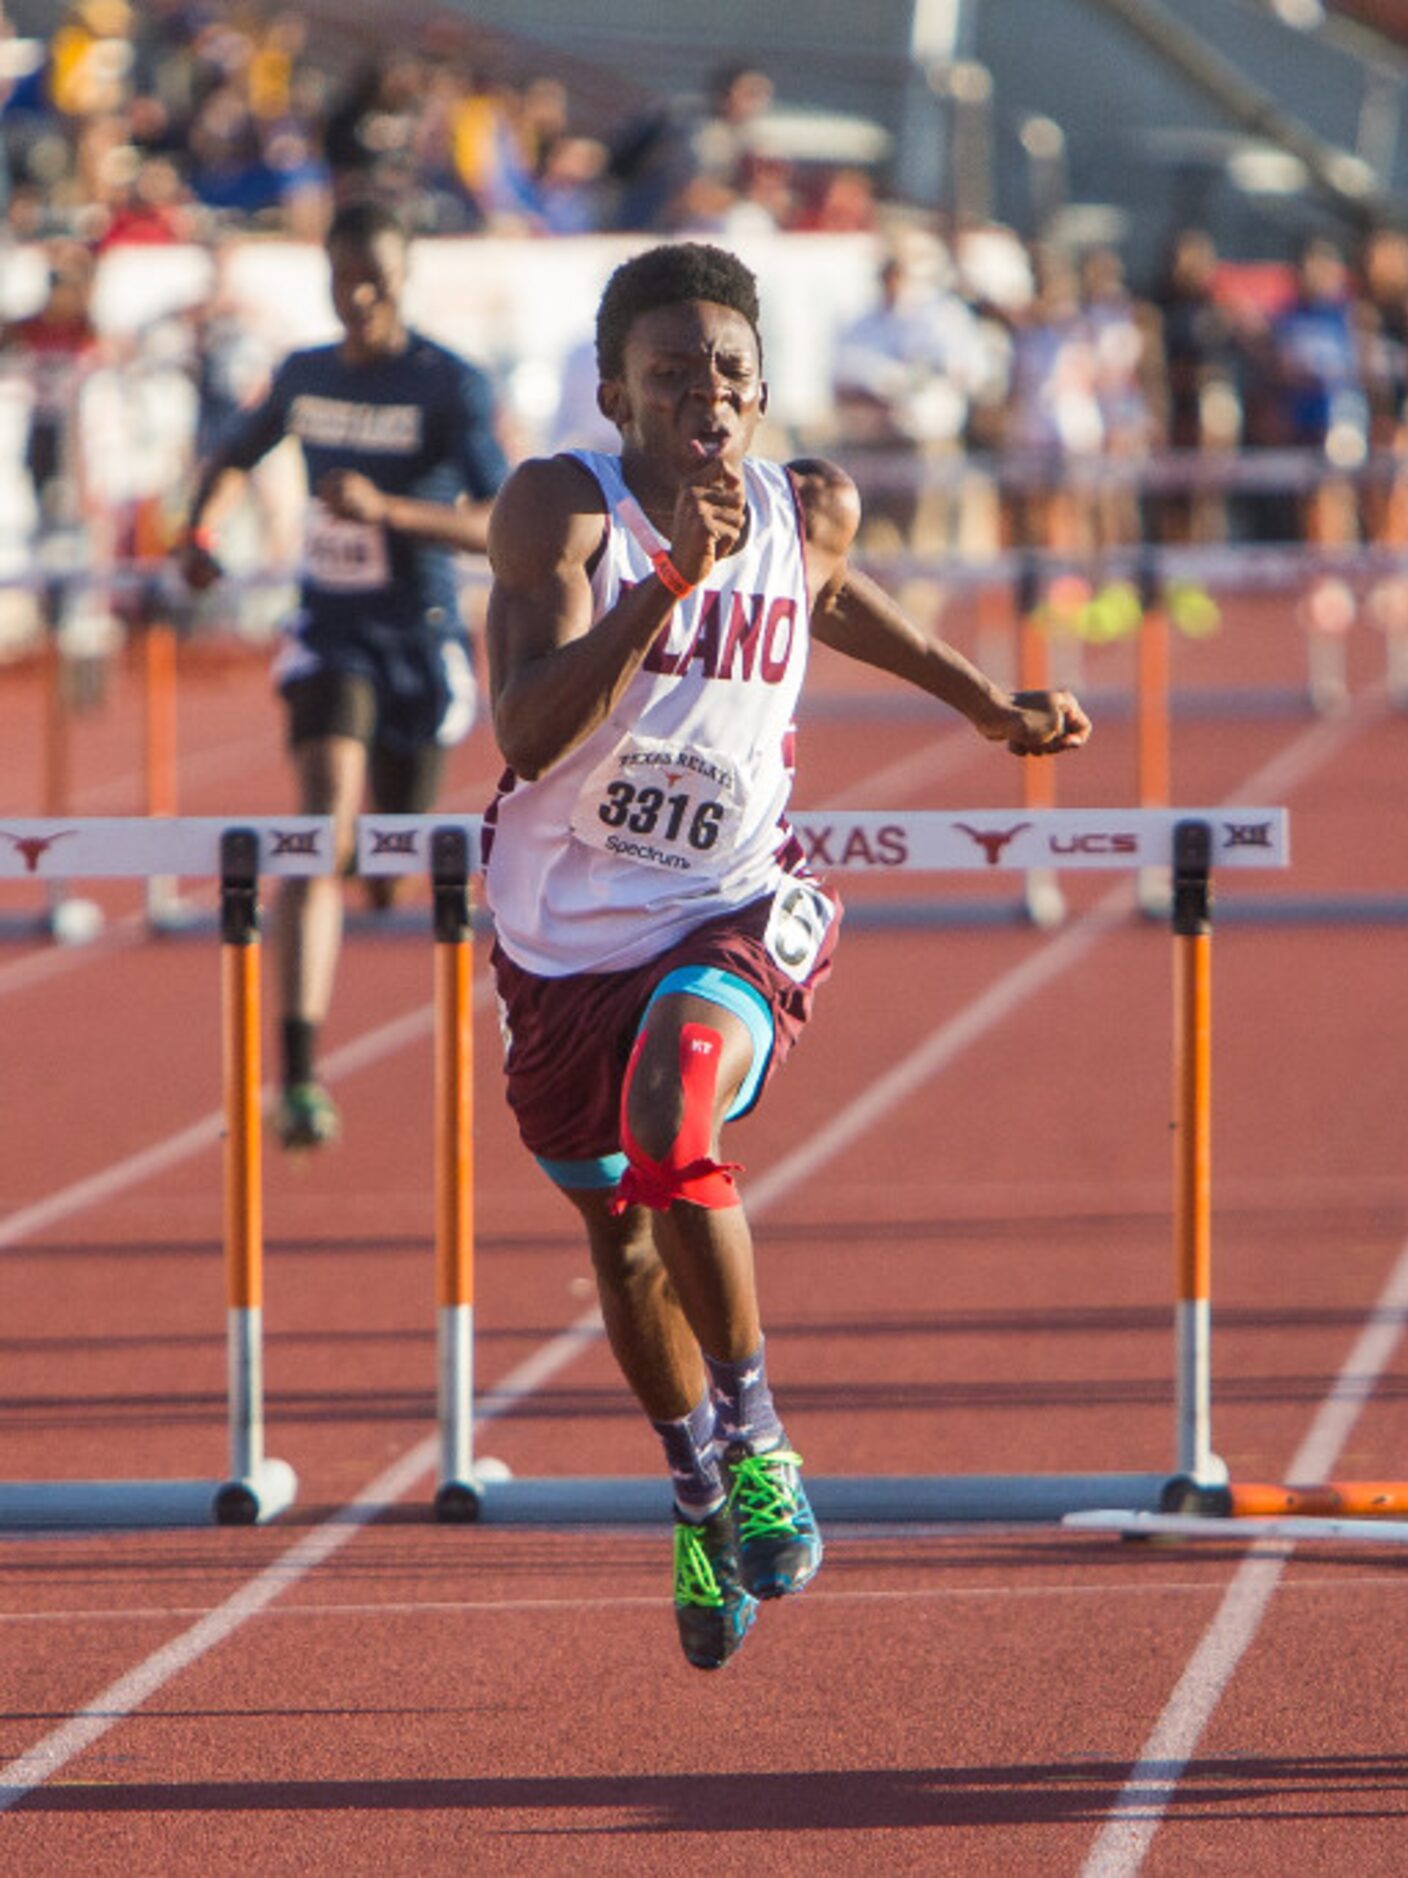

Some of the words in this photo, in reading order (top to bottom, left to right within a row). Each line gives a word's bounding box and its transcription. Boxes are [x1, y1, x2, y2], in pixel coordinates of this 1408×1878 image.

[618, 578, 797, 684] LANO
[619, 751, 672, 767] TEXAS
[599, 781, 725, 850] 3316
[605, 835, 687, 869] Spectrum
[803, 826, 908, 866] XAS
